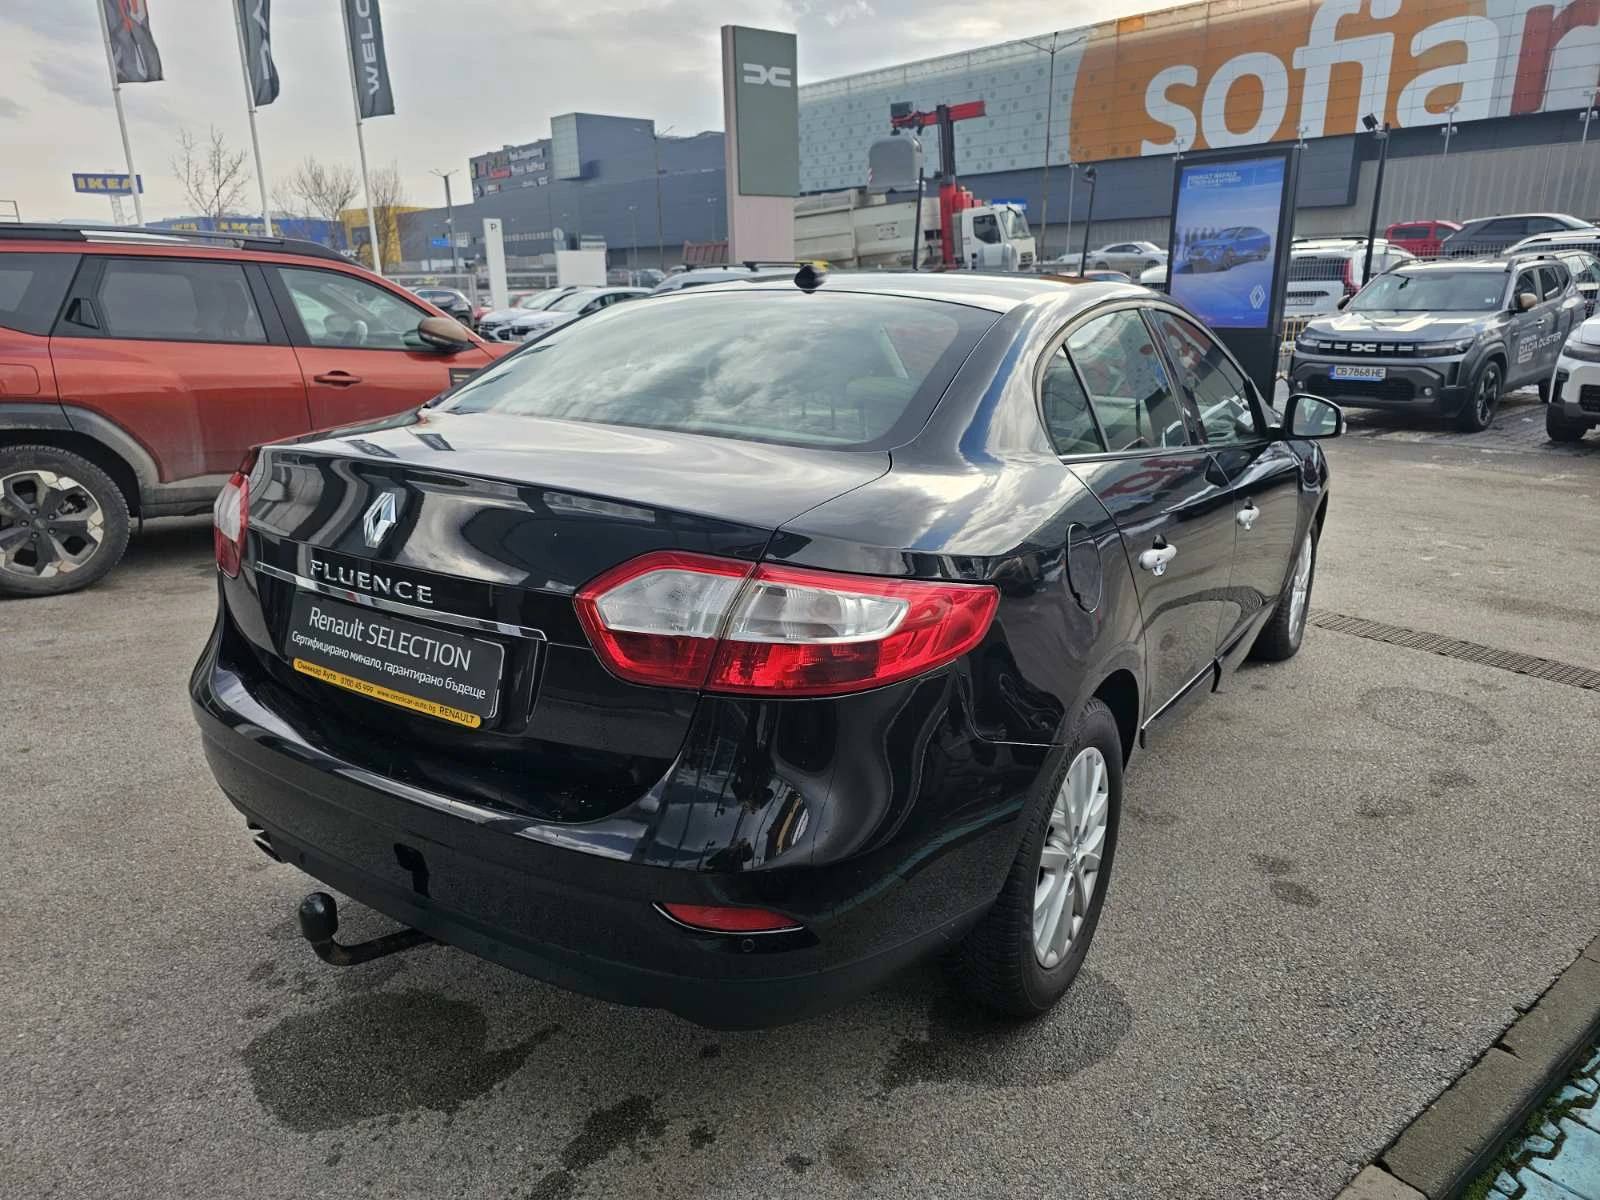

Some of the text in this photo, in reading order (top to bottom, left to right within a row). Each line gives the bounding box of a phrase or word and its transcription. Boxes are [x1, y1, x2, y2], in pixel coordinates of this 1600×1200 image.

[1140, 0, 1500, 158] sofia
[77, 177, 135, 190] IKEA
[310, 559, 434, 604] FLUENCE
[291, 630, 486, 700] Сертифицирано минало, гарантирано бъдеще
[309, 606, 472, 671] Renault SELECTION
[439, 705, 475, 724] RENAULT
